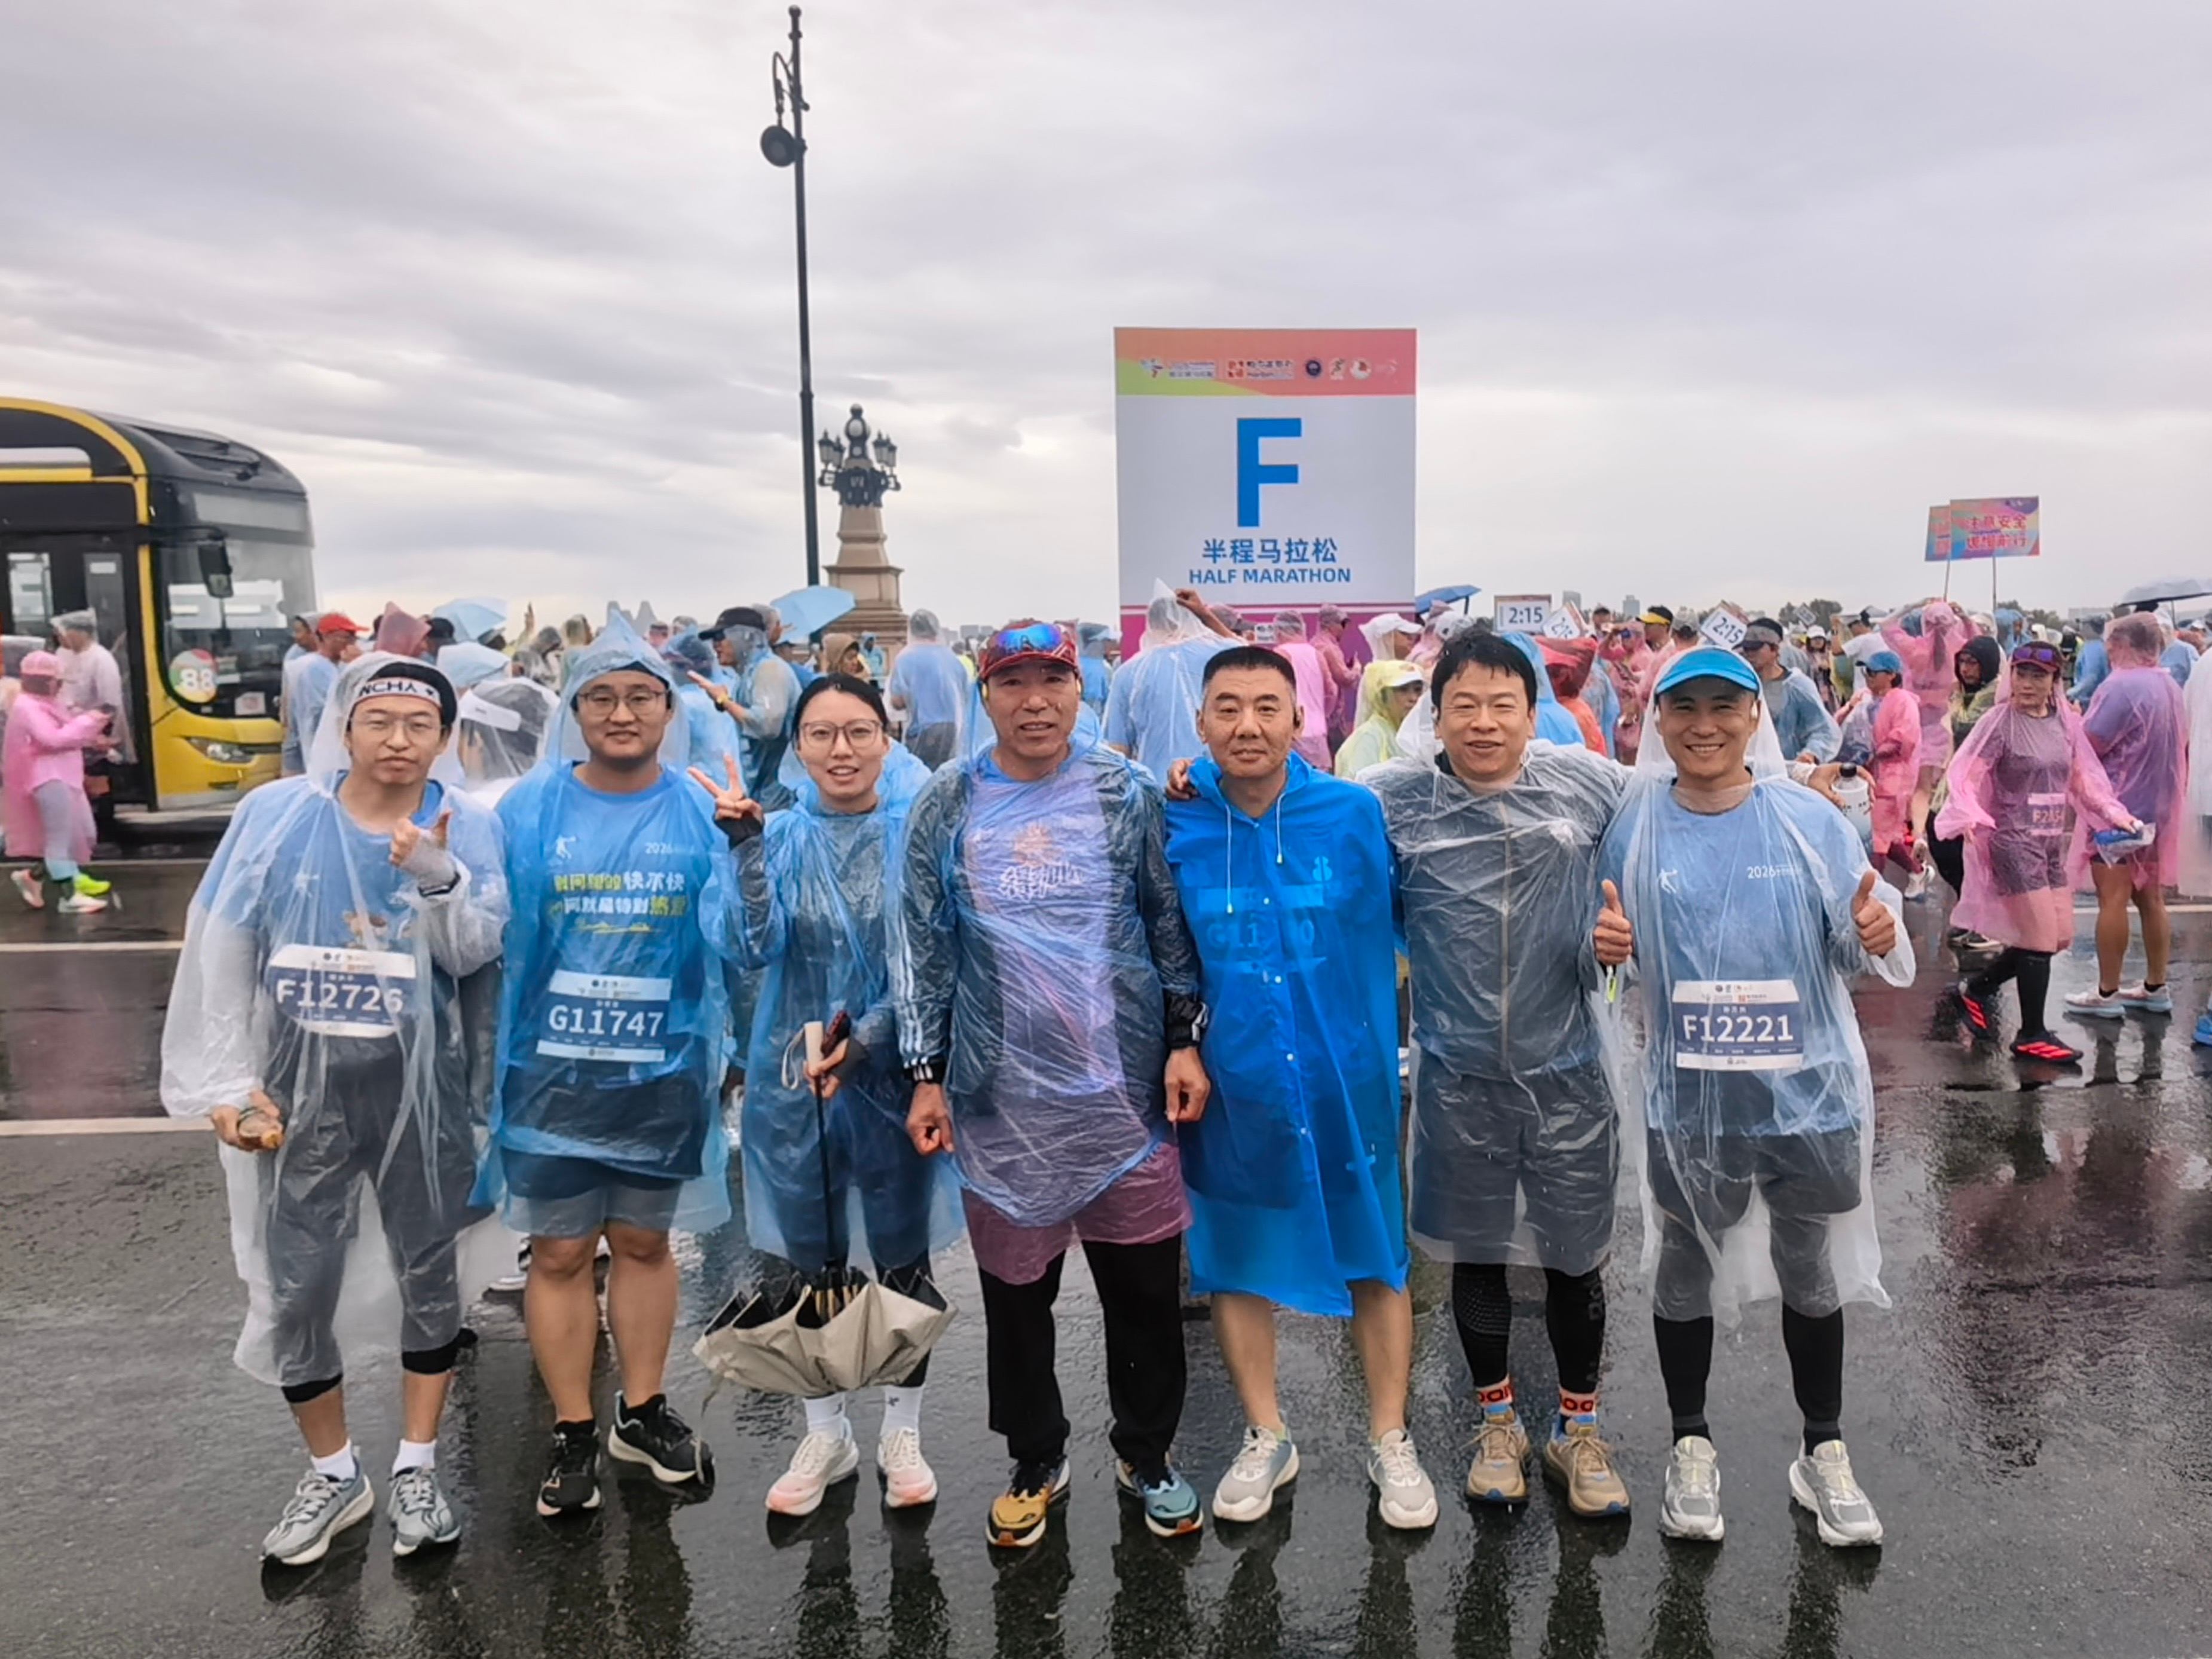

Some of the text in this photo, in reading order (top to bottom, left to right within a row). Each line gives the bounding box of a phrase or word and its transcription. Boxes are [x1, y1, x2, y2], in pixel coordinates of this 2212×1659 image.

[1237, 418, 1302, 527] F
[1203, 538, 1338, 564] 半程马拉松
[1189, 568, 1351, 584] HALF MARATHON
[1509, 607, 1543, 623] 2:15
[1712, 616, 1743, 644] 2:15
[180, 668, 216, 690] 88
[1746, 865, 1776, 879] 2026
[276, 978, 404, 1014] F12726
[549, 1005, 664, 1037] G11747
[1682, 1015, 1794, 1043] F12221
